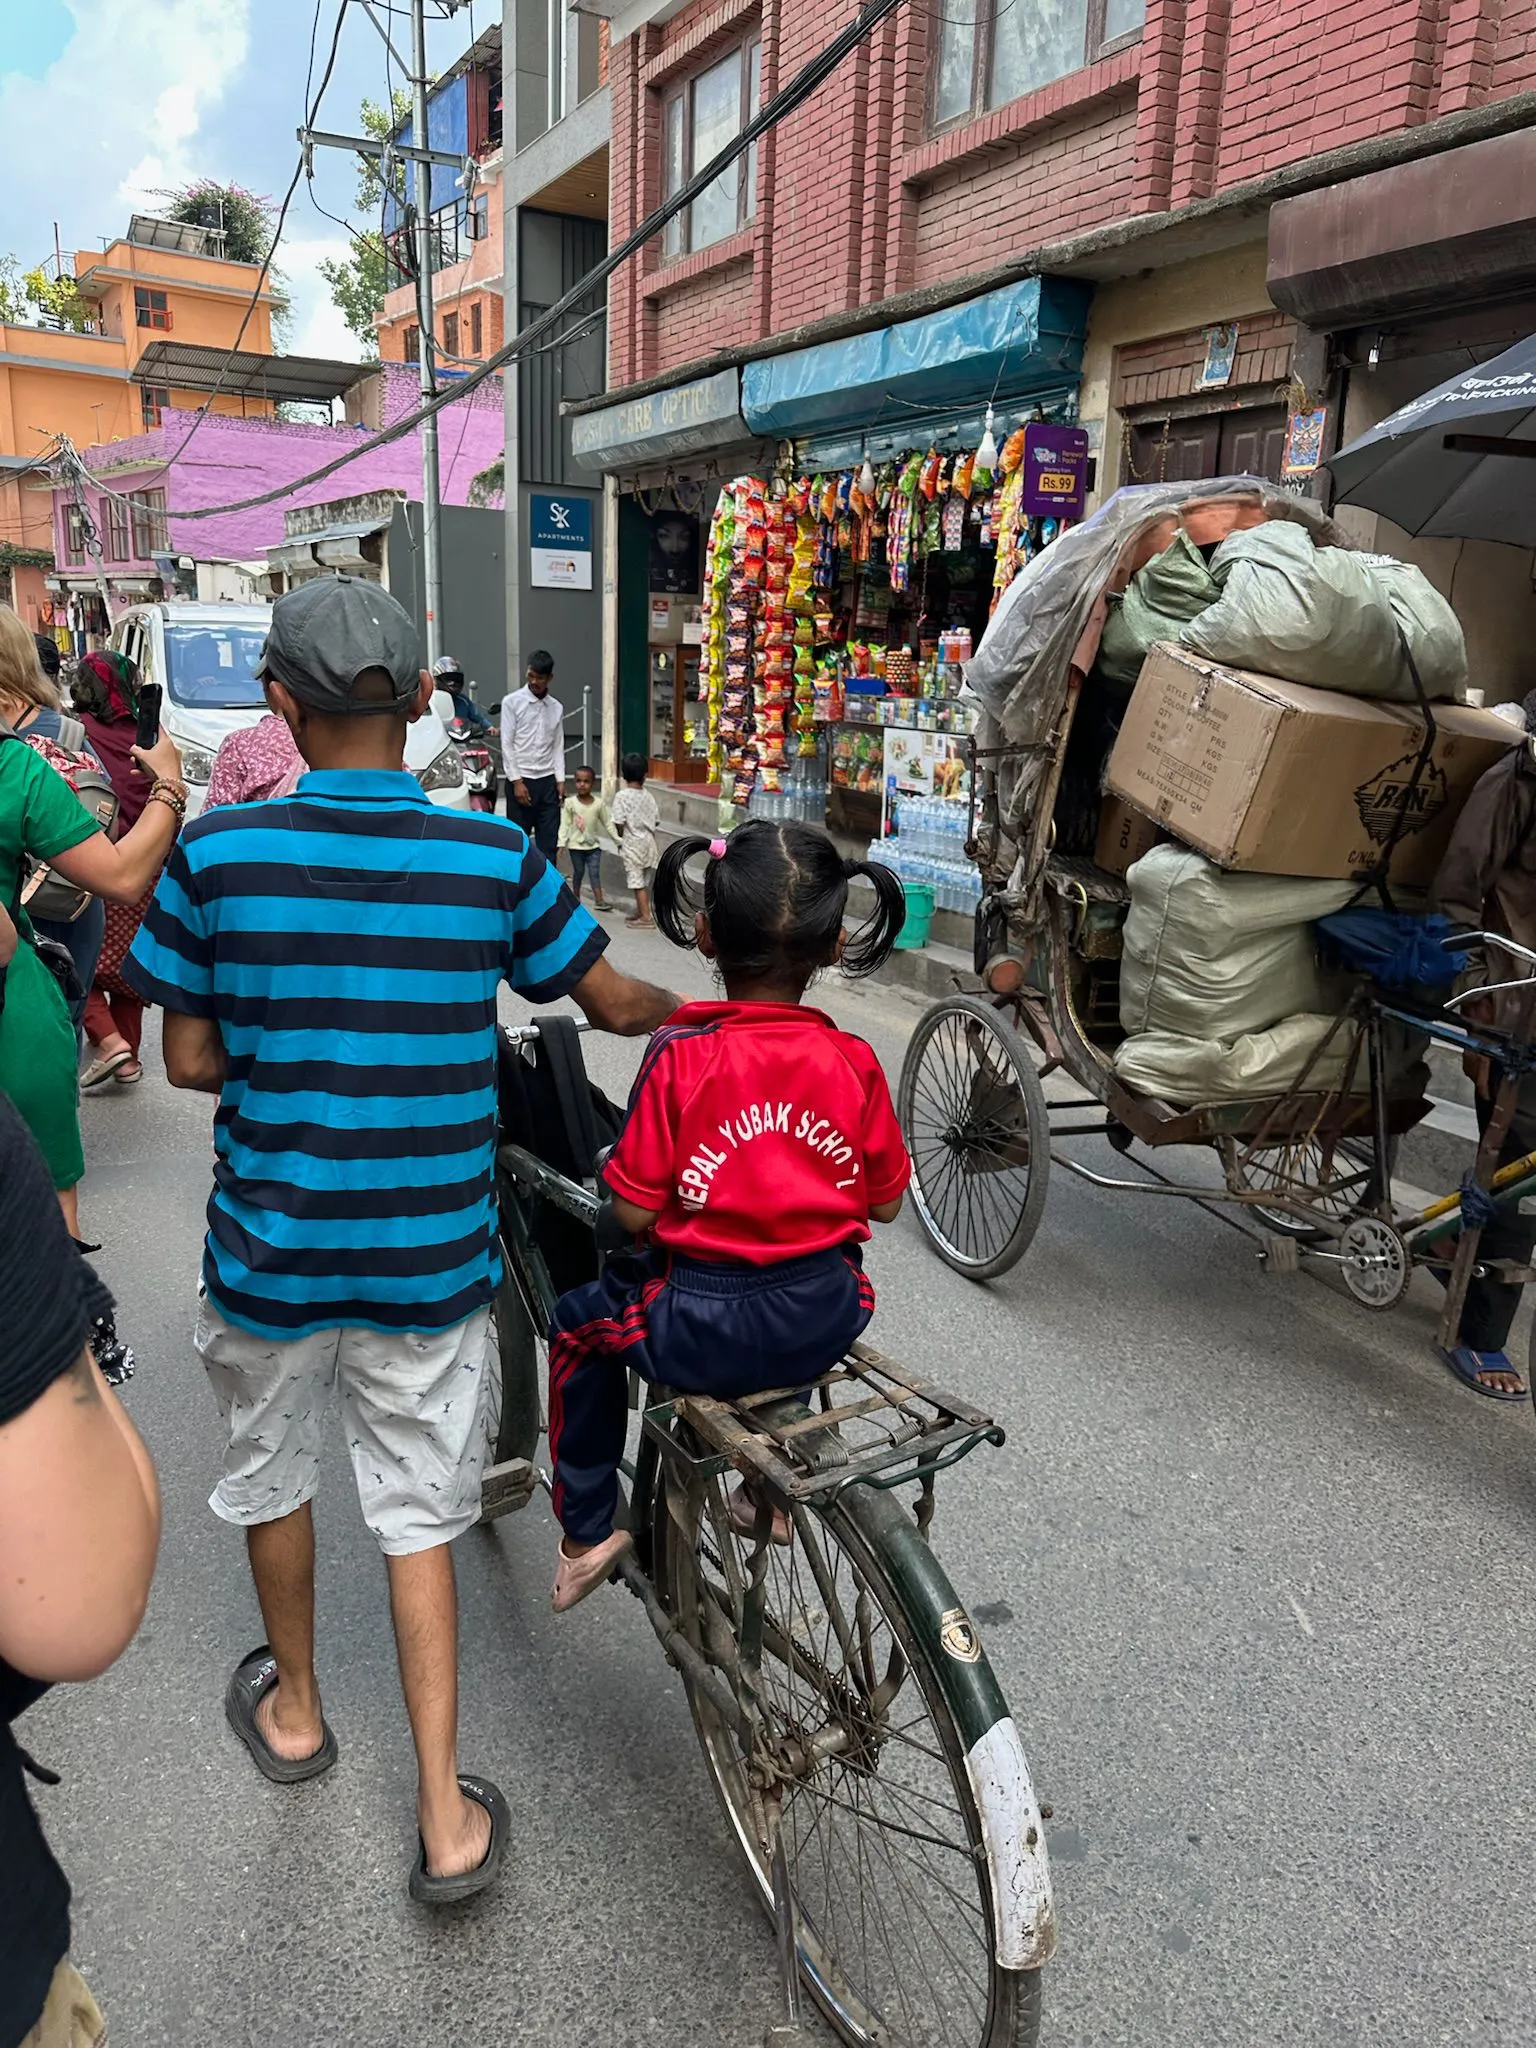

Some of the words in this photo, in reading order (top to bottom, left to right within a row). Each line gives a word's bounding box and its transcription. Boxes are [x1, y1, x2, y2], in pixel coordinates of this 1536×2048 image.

[537, 532, 585, 542] APARTMENTS
[1210, 735, 1227, 750] PRS
[718, 1101, 793, 1149] YUBAK
